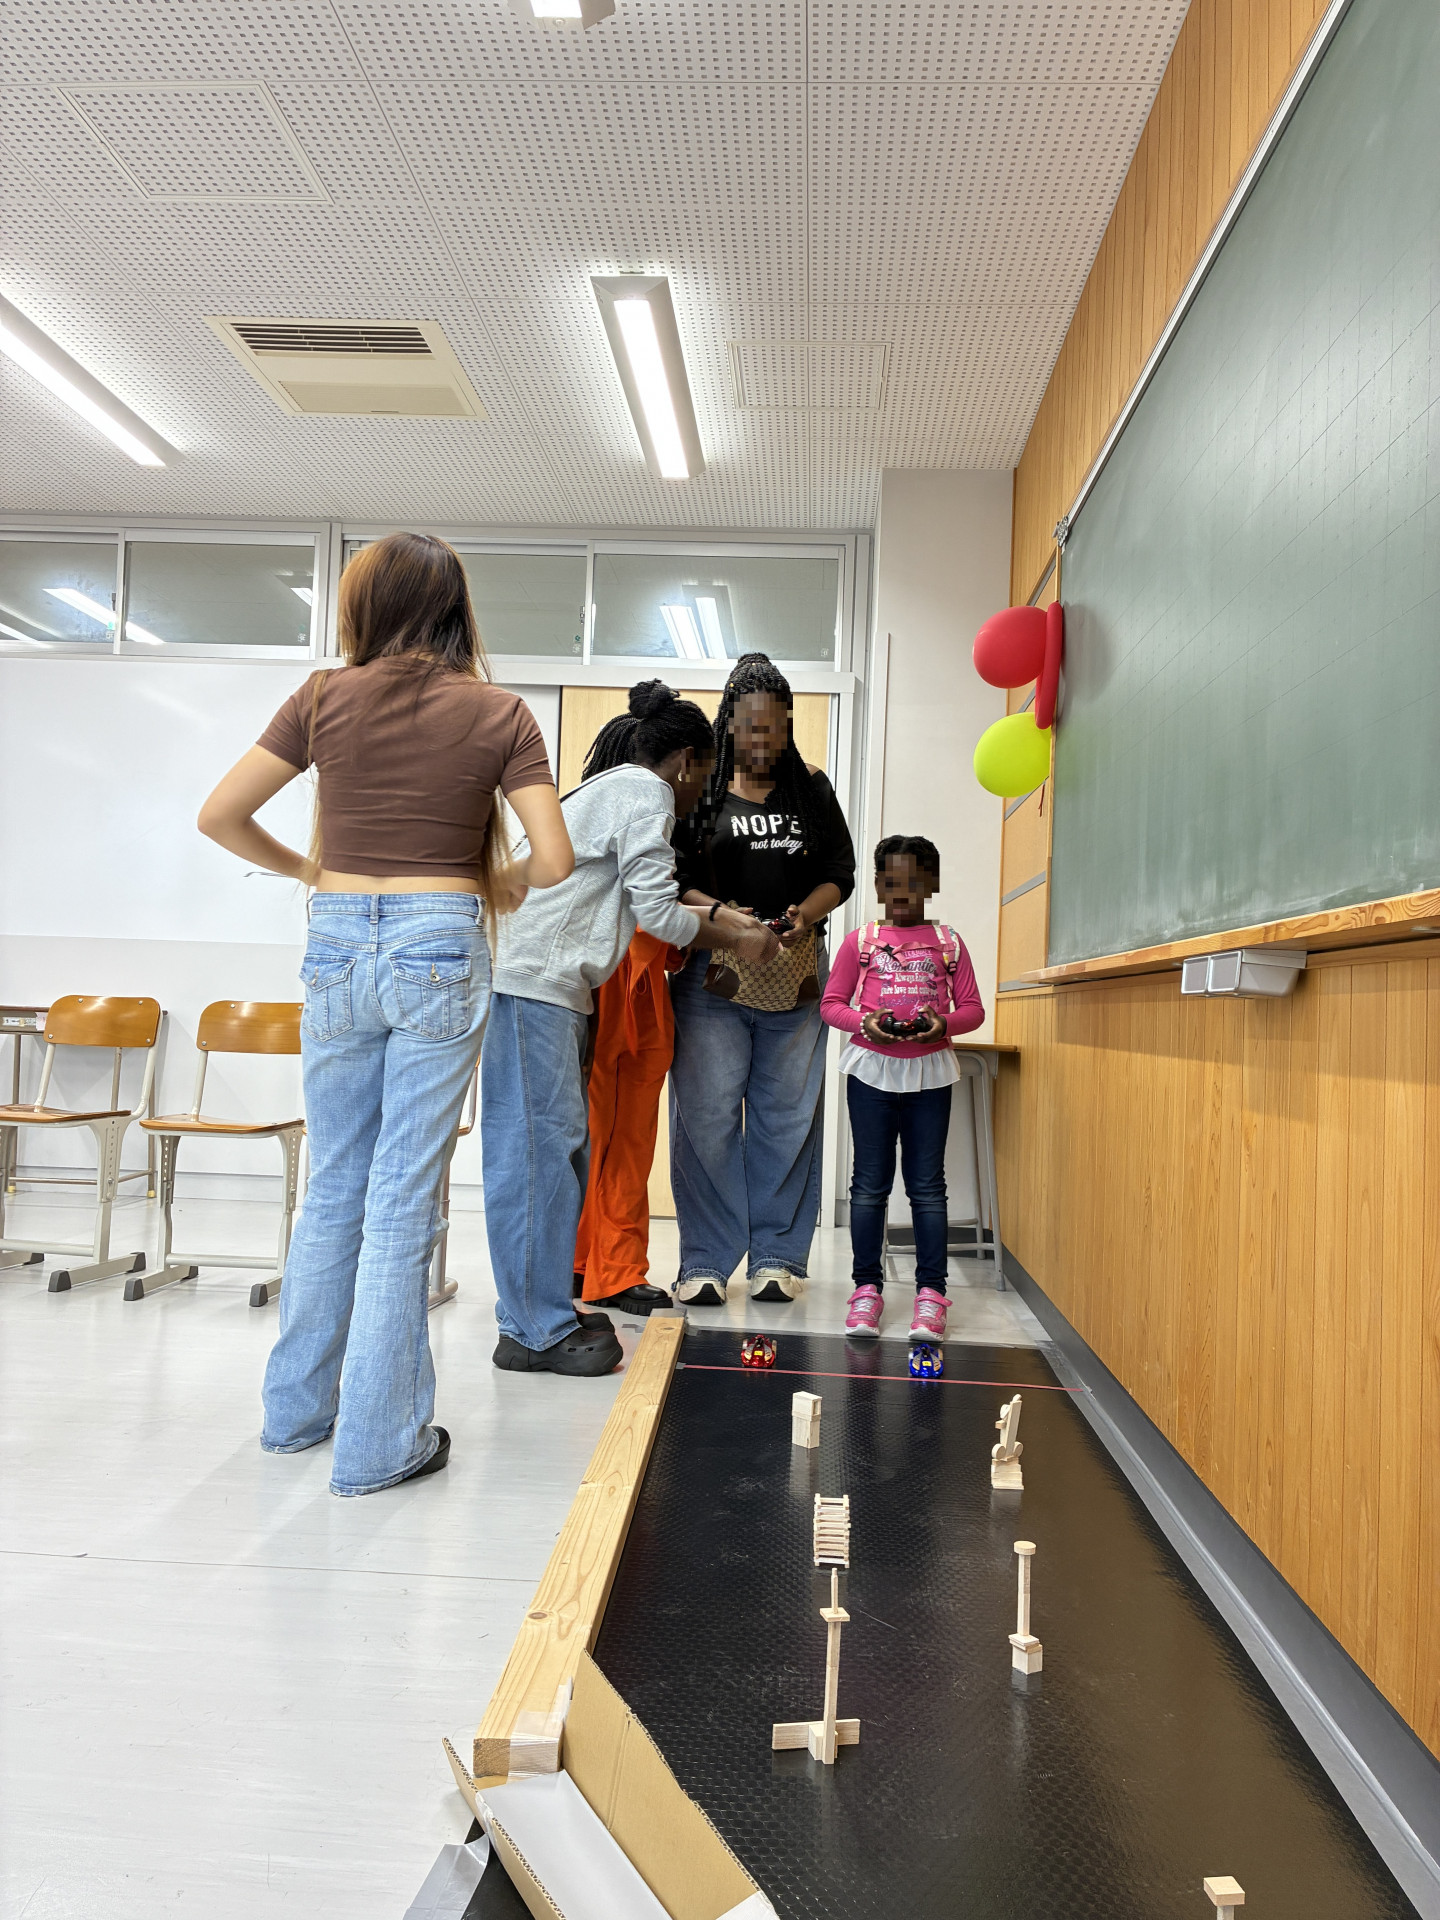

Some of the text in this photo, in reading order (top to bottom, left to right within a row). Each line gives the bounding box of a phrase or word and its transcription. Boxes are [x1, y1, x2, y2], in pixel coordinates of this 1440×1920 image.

[750, 835, 803, 855] not today
[894, 984, 906, 995] love
